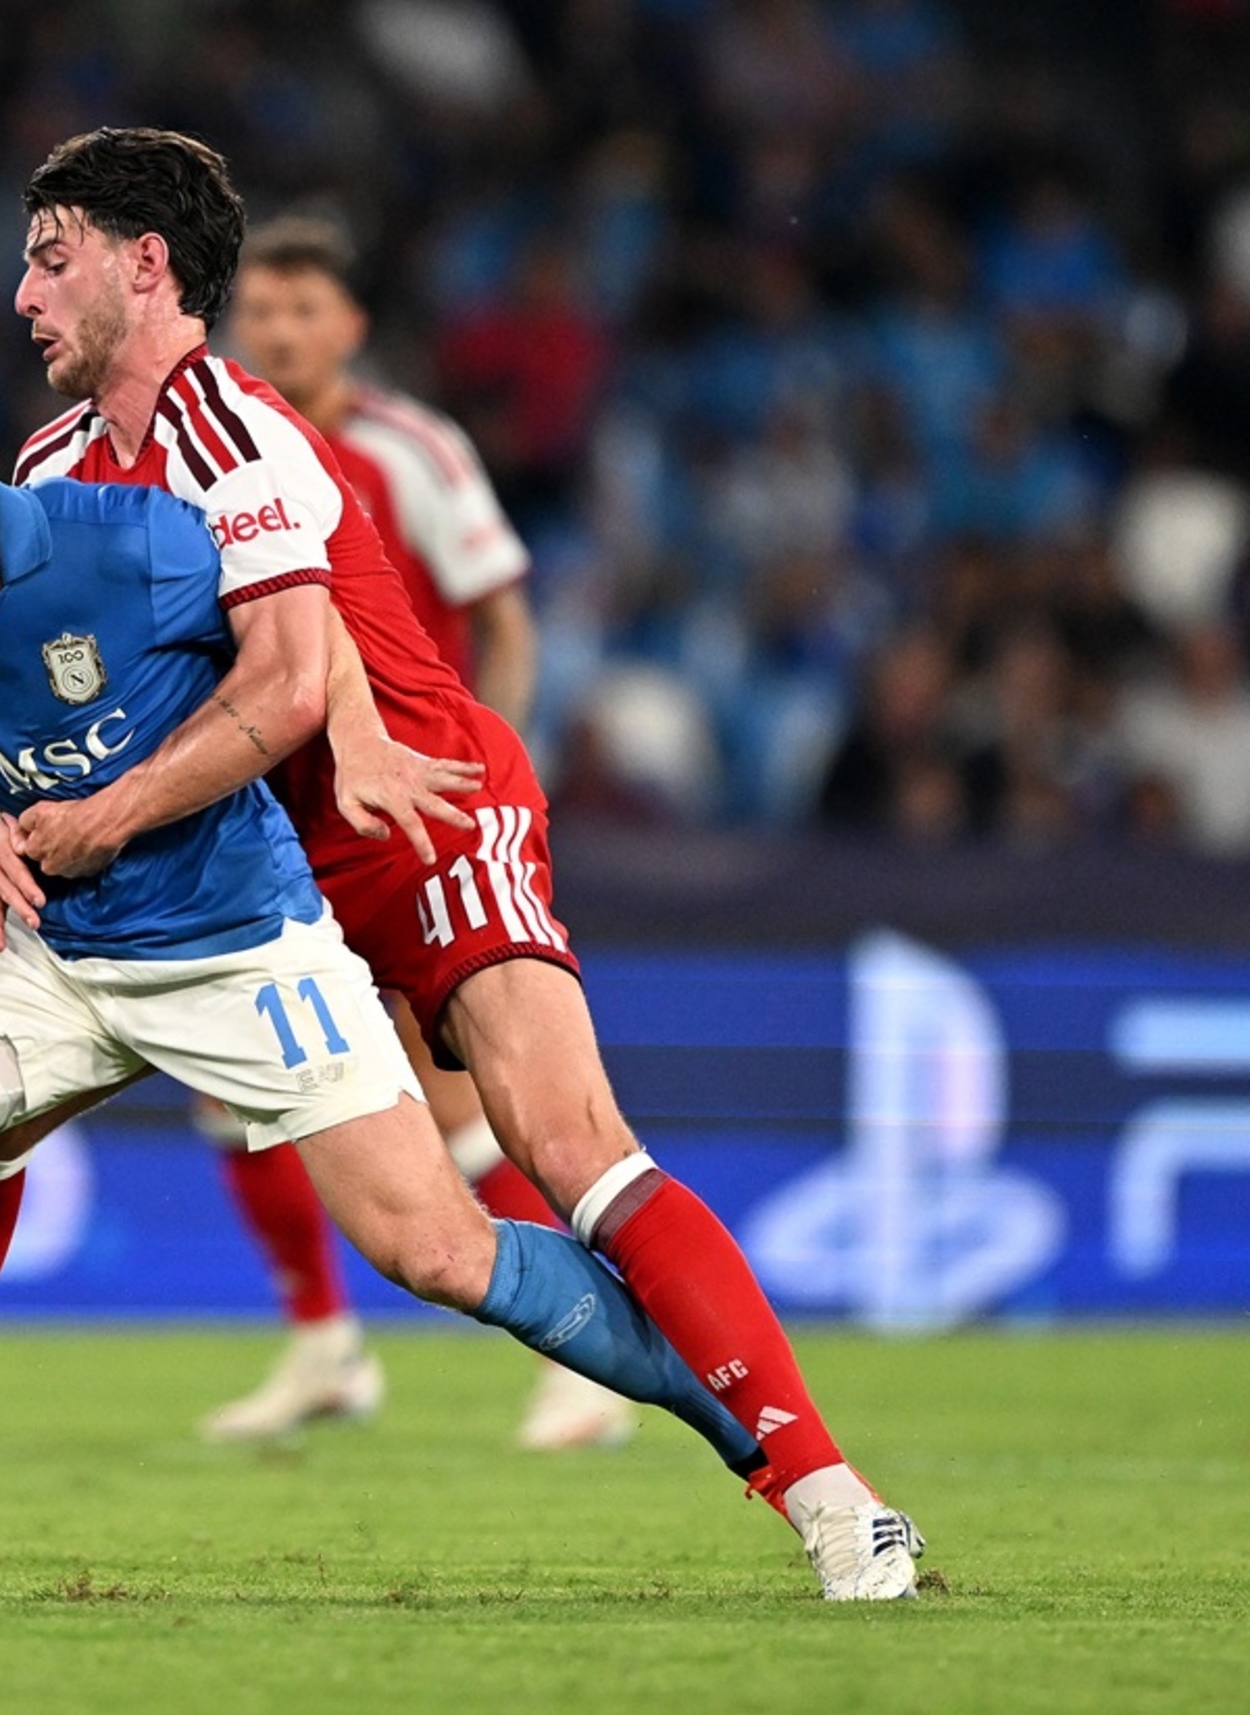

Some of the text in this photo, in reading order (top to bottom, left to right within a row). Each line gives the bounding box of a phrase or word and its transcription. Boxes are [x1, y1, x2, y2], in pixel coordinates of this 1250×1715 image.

[209, 497, 301, 550] deel.
[415, 853, 489, 949] 41
[254, 976, 351, 1070] 11
[707, 1358, 749, 1392] AFC
